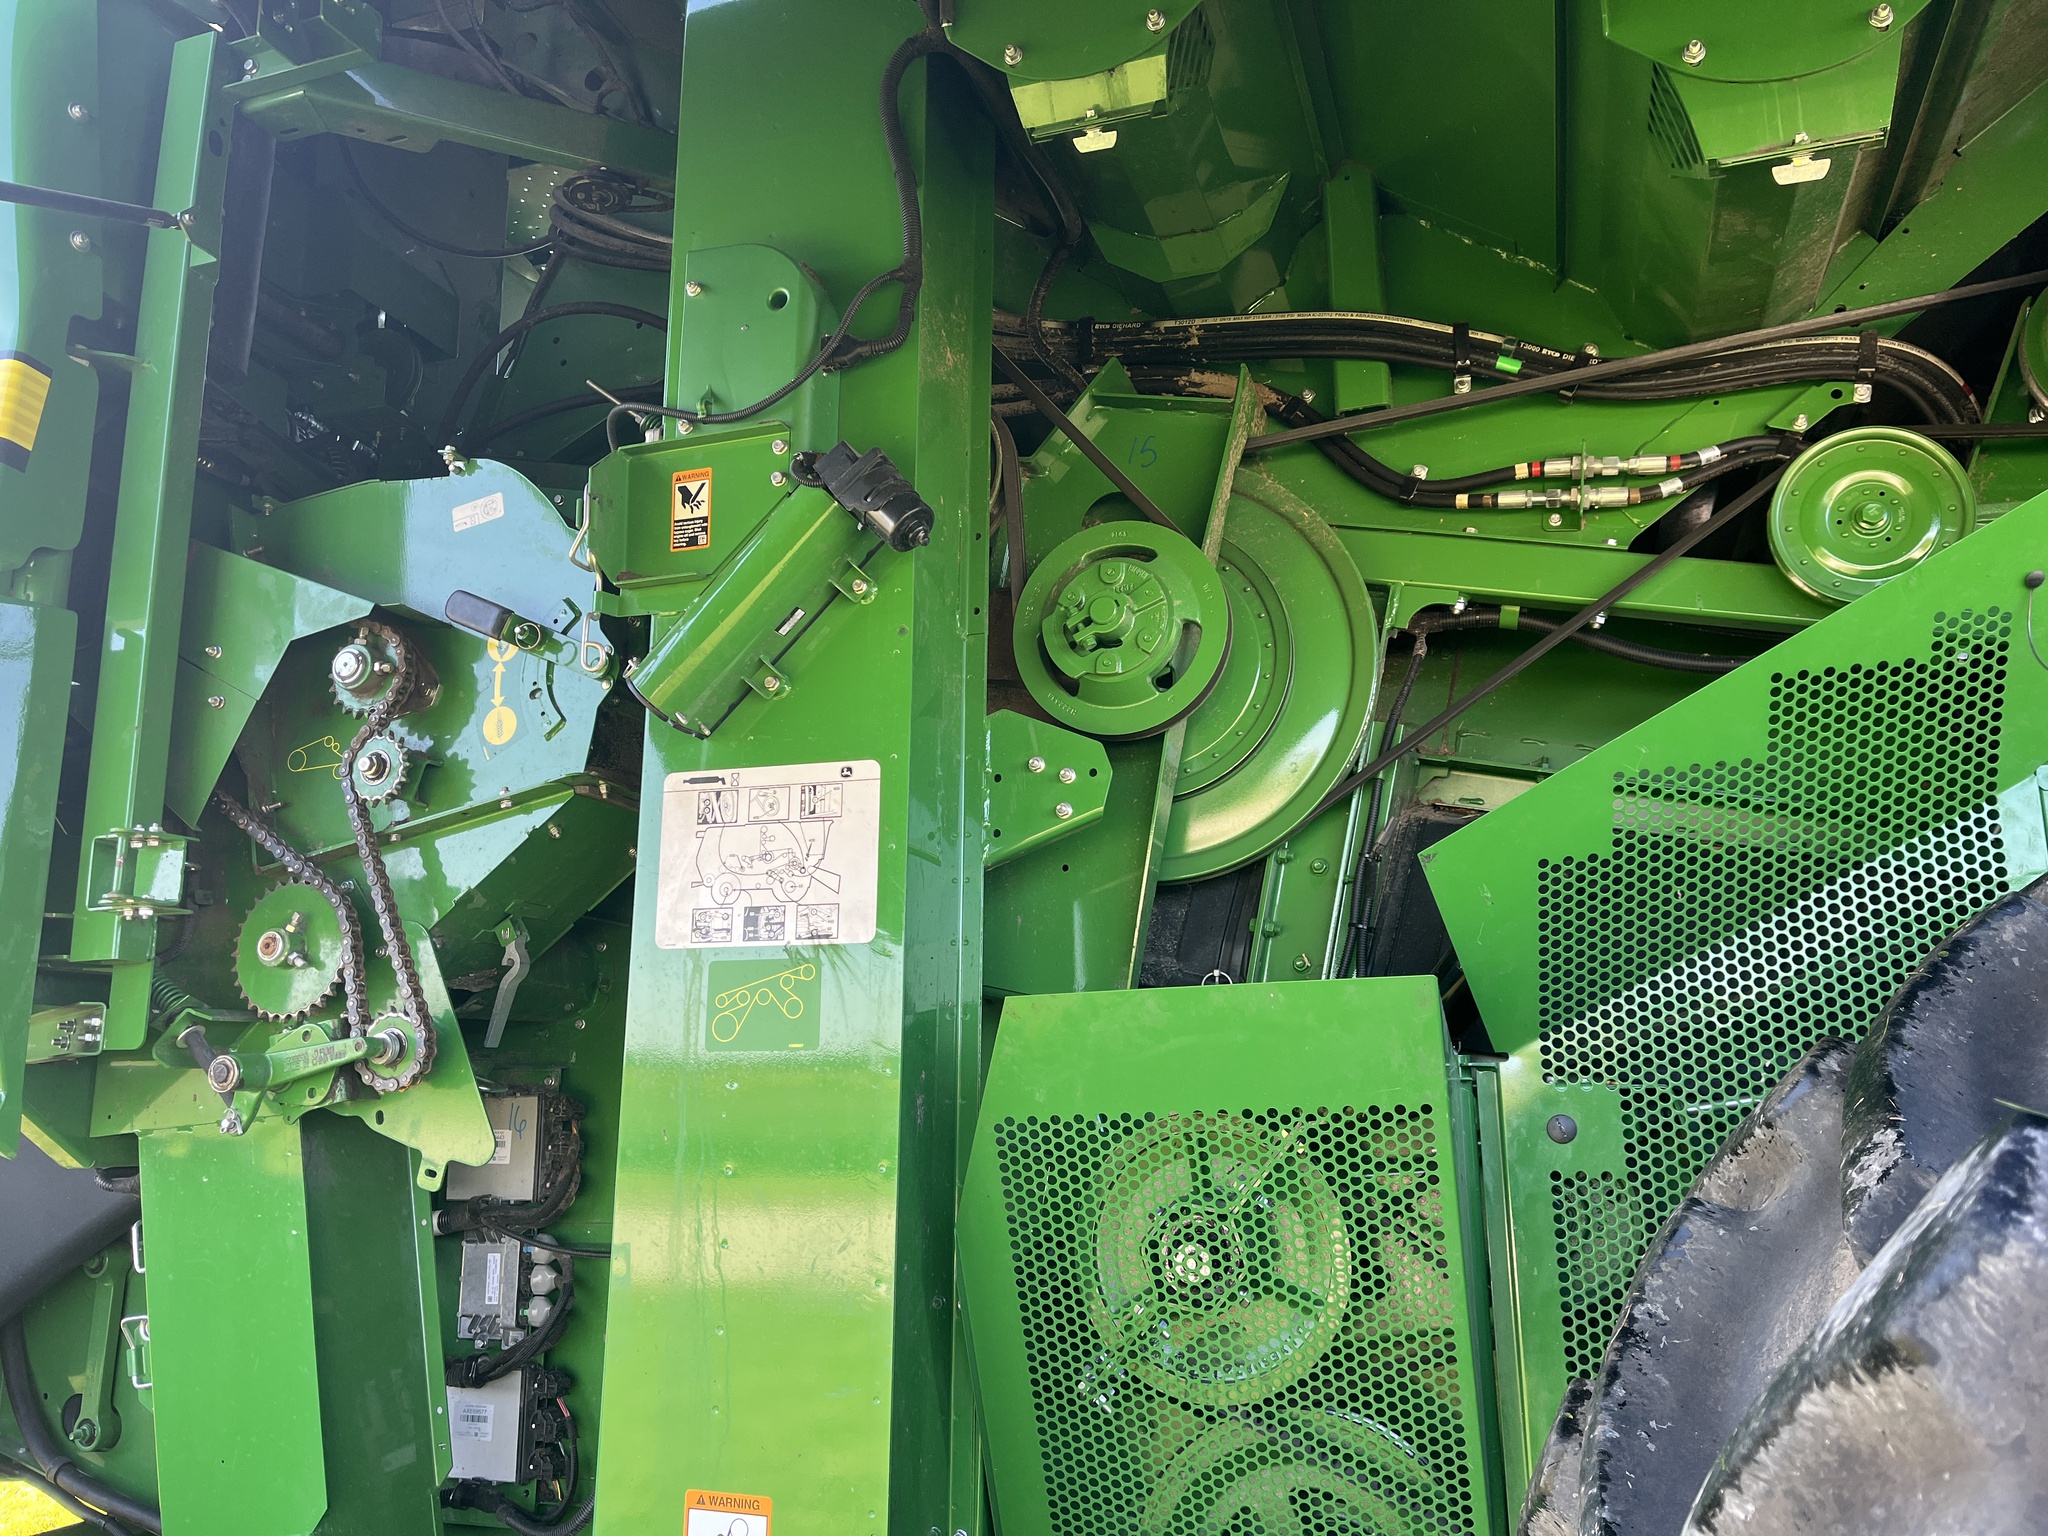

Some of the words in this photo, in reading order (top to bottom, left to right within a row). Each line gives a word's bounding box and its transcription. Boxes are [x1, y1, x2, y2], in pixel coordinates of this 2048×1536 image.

[1384, 315, 1412, 324] RESISTANT
[1520, 341, 1540, 352] T3000
[1128, 434, 1158, 468] 15
[682, 470, 709, 481] WARNING
[509, 1103, 527, 1140] 16
[708, 1496, 760, 1510] WARNING
